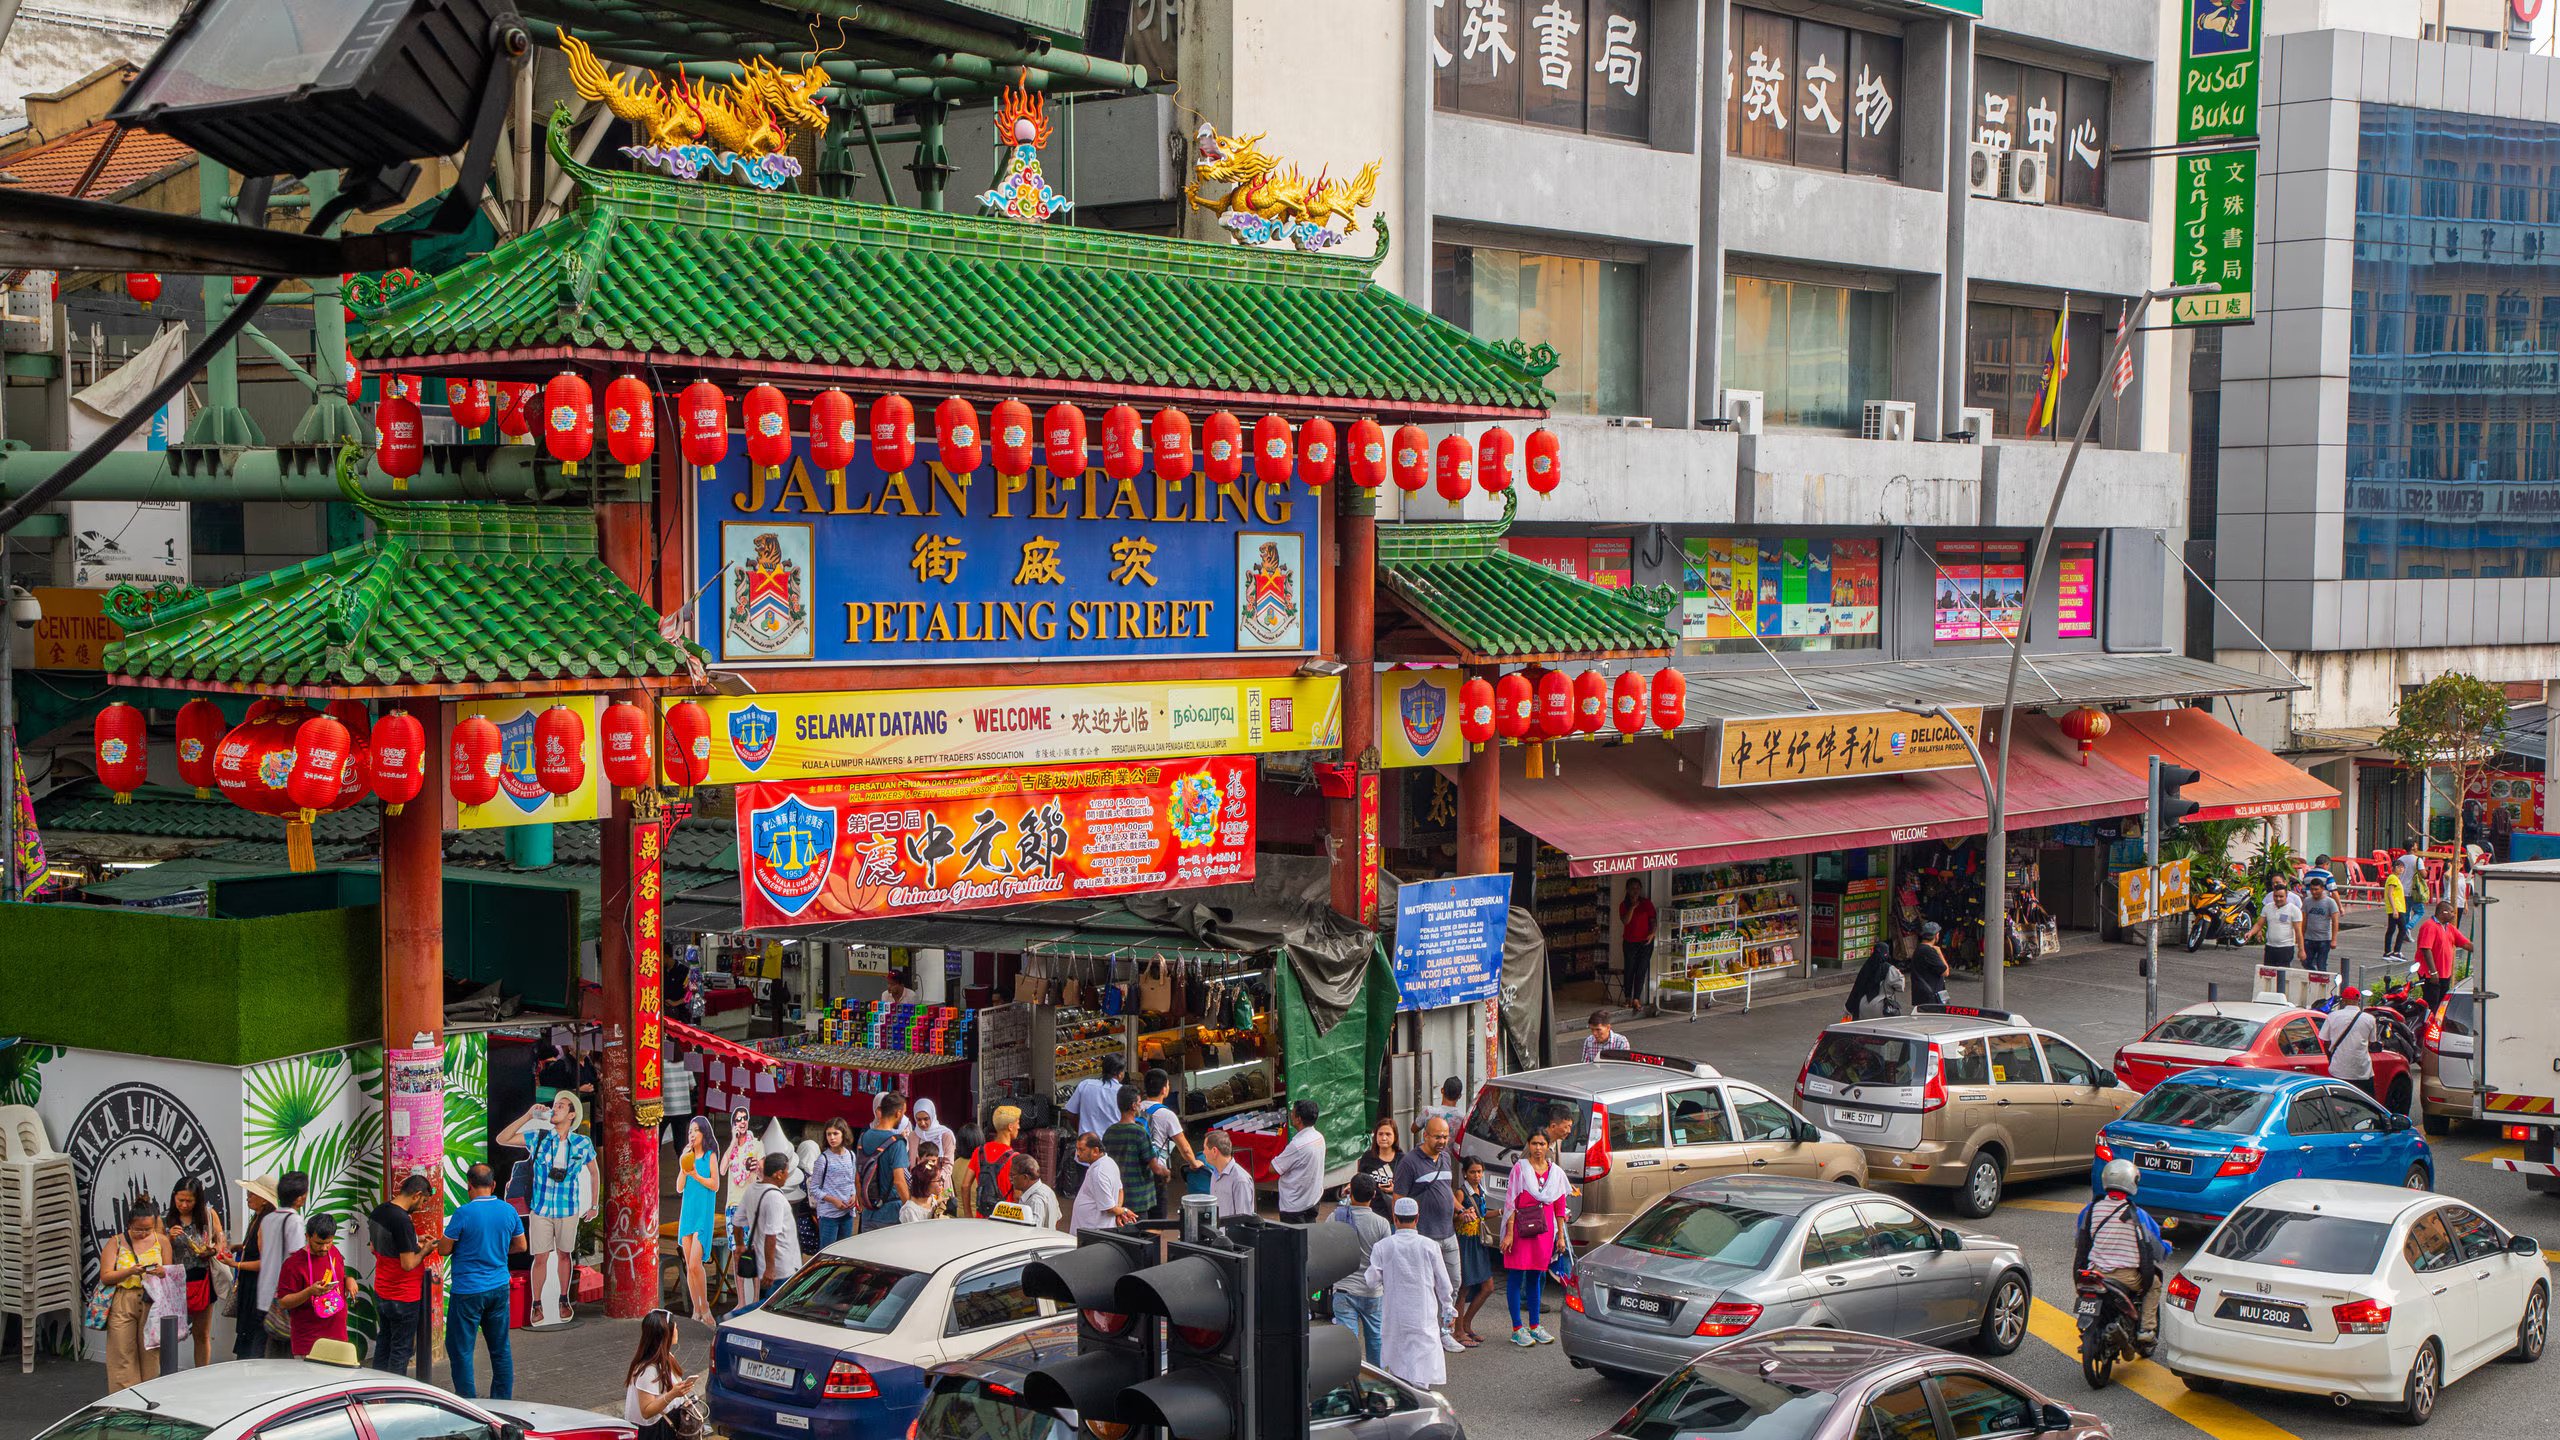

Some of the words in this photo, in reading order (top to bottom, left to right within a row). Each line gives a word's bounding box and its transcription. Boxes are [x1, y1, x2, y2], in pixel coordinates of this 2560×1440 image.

[2222, 162, 2245, 282] 文殊書局
[2184, 298, 2242, 317] 入口處
[734, 453, 967, 517] JALAN
[990, 463, 1295, 525] PETALING
[105, 573, 134, 582] SAYANGI
[135, 573, 157, 582] KUALA
[158, 574, 185, 585] LUMPUR
[846, 601, 1058, 643] PETALING
[1069, 600, 1214, 641] STREET
[795, 713, 875, 741] SELAMAT
[879, 709, 948, 737] DATANG
[973, 706, 1051, 733] WELCOME
[1071, 706, 1149, 734] 欢迎光临
[1248, 689, 1262, 745] 丙申年
[1731, 725, 1884, 779] 中华行伴手礼
[1917, 744, 1944, 753] MALAYSIA
[801, 760, 829, 770] KUALA
[830, 758, 863, 769] LUMPUR
[907, 756, 913, 764] &
[914, 755, 938, 764] PETTY
[977, 750, 1024, 761] ASSOCIATION
[849, 781, 896, 791] PERSATUAN
[898, 780, 930, 789] PENJAJA
[948, 777, 981, 786] PENIAGA
[982, 776, 1002, 784] KECIL
[1021, 767, 1162, 791] 吉隆坡小販商業公會
[912, 789, 938, 798] PETTY
[972, 783, 1018, 795] ASSOCIATION
[1090, 800, 1114, 808] 1/8/19
[1116, 797, 1149, 807] (5.00pm)
[2248, 805, 2261, 814] JALAN
[2295, 801, 2308, 810] KUALA
[1089, 825, 1112, 833] 2/8/19
[1114, 822, 1153, 832] (11.00pm)
[1890, 826, 1928, 842] WELCOME
[906, 795, 1068, 888] 中元節
[1090, 859, 1114, 867] 4/8/19
[1116, 856, 1151, 866] (7.00pm)
[1592, 857, 1636, 874] SELAMAT
[1642, 853, 1678, 869] DATANG
[772, 873, 791, 887] KUALA
[792, 871, 817, 888] LUMPUR
[785, 869, 803, 878] 1953
[783, 887, 799, 896] PETTY
[887, 886, 949, 906] Chinese
[949, 879, 999, 904] Ghost
[1000, 873, 1065, 899] Festival
[1435, 911, 1452, 921] JALAN
[1452, 908, 1477, 919] PETALING
[870, 961, 877, 970] 17
[1405, 981, 1426, 991] TALIAN
[1841, 1111, 1856, 1121] HWE
[1858, 1112, 1875, 1123] 5717
[2144, 1156, 2160, 1167] VCM
[2166, 1159, 2181, 1171] 7151
[1620, 1296, 1638, 1308] WSC
[1639, 1300, 1659, 1312] 8188
[2239, 1305, 2261, 1319] WUU
[2262, 1309, 2290, 1323] 2808
[746, 1361, 763, 1377] HWD
[765, 1365, 786, 1382] 6254
